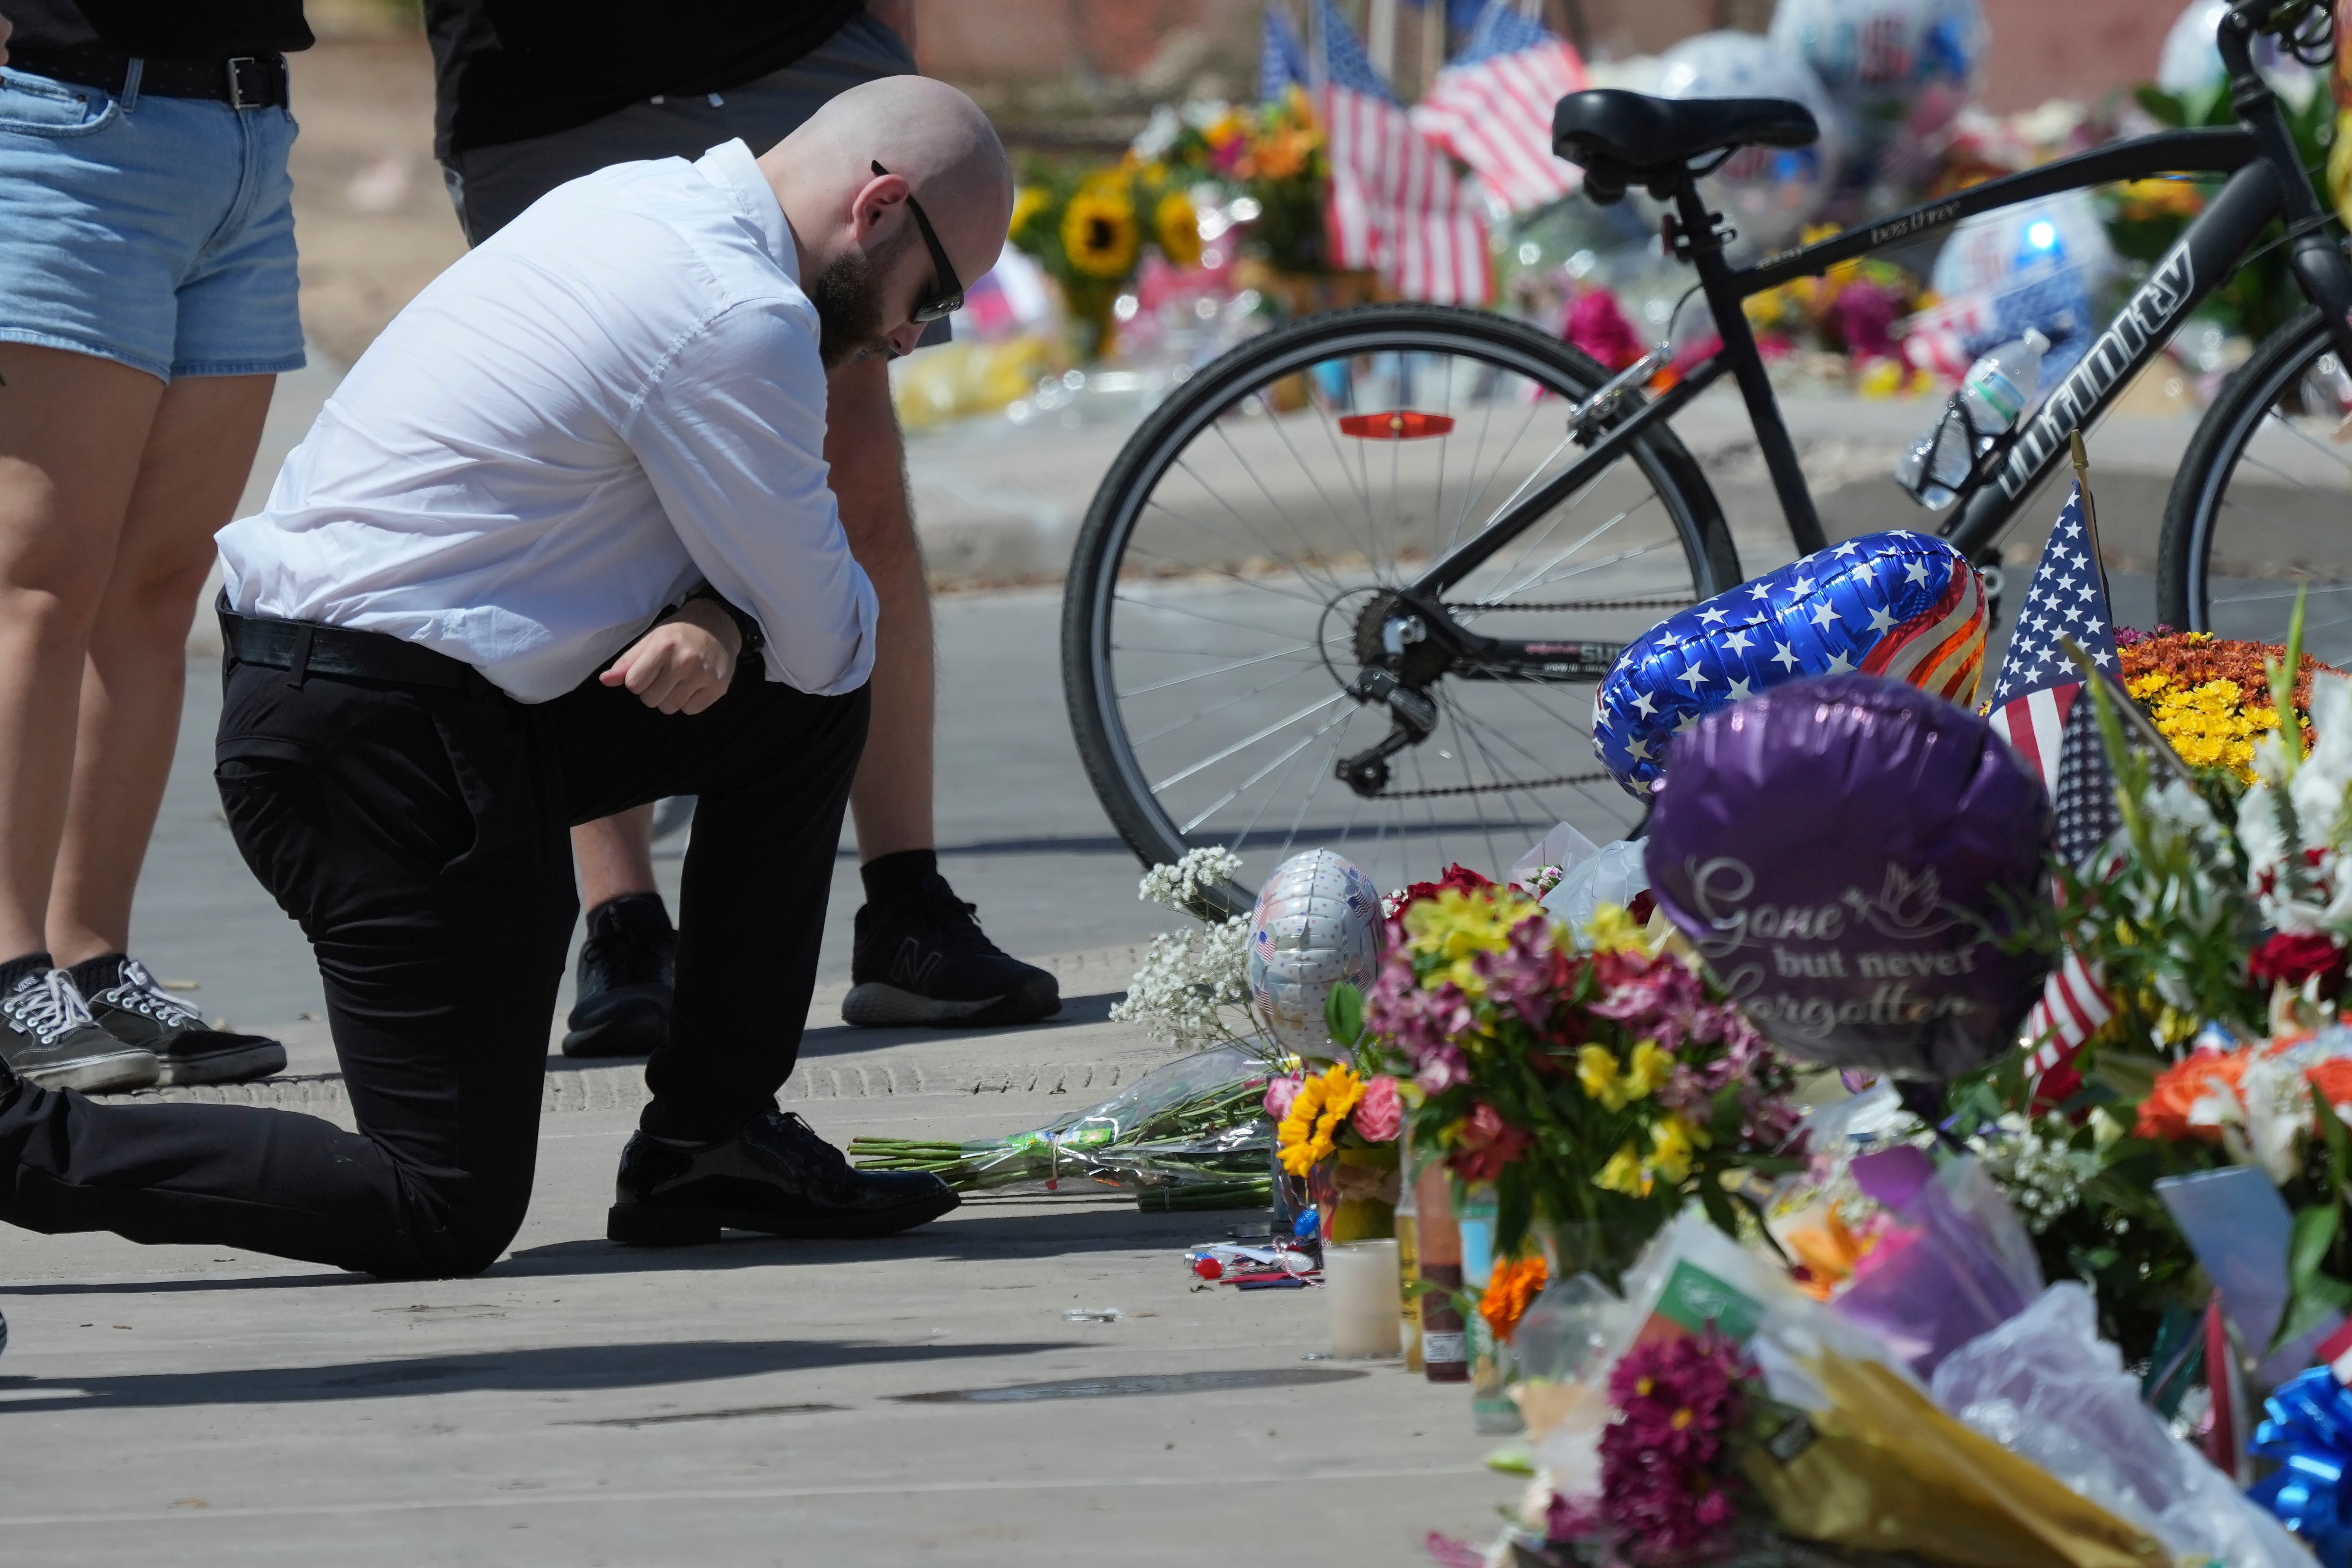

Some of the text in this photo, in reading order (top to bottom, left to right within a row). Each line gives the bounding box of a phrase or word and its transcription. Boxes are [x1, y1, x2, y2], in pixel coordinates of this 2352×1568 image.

[1685, 855, 1845, 958] Gone
[1773, 946, 1976, 978] but never
[14, 976, 37, 992] VANS
